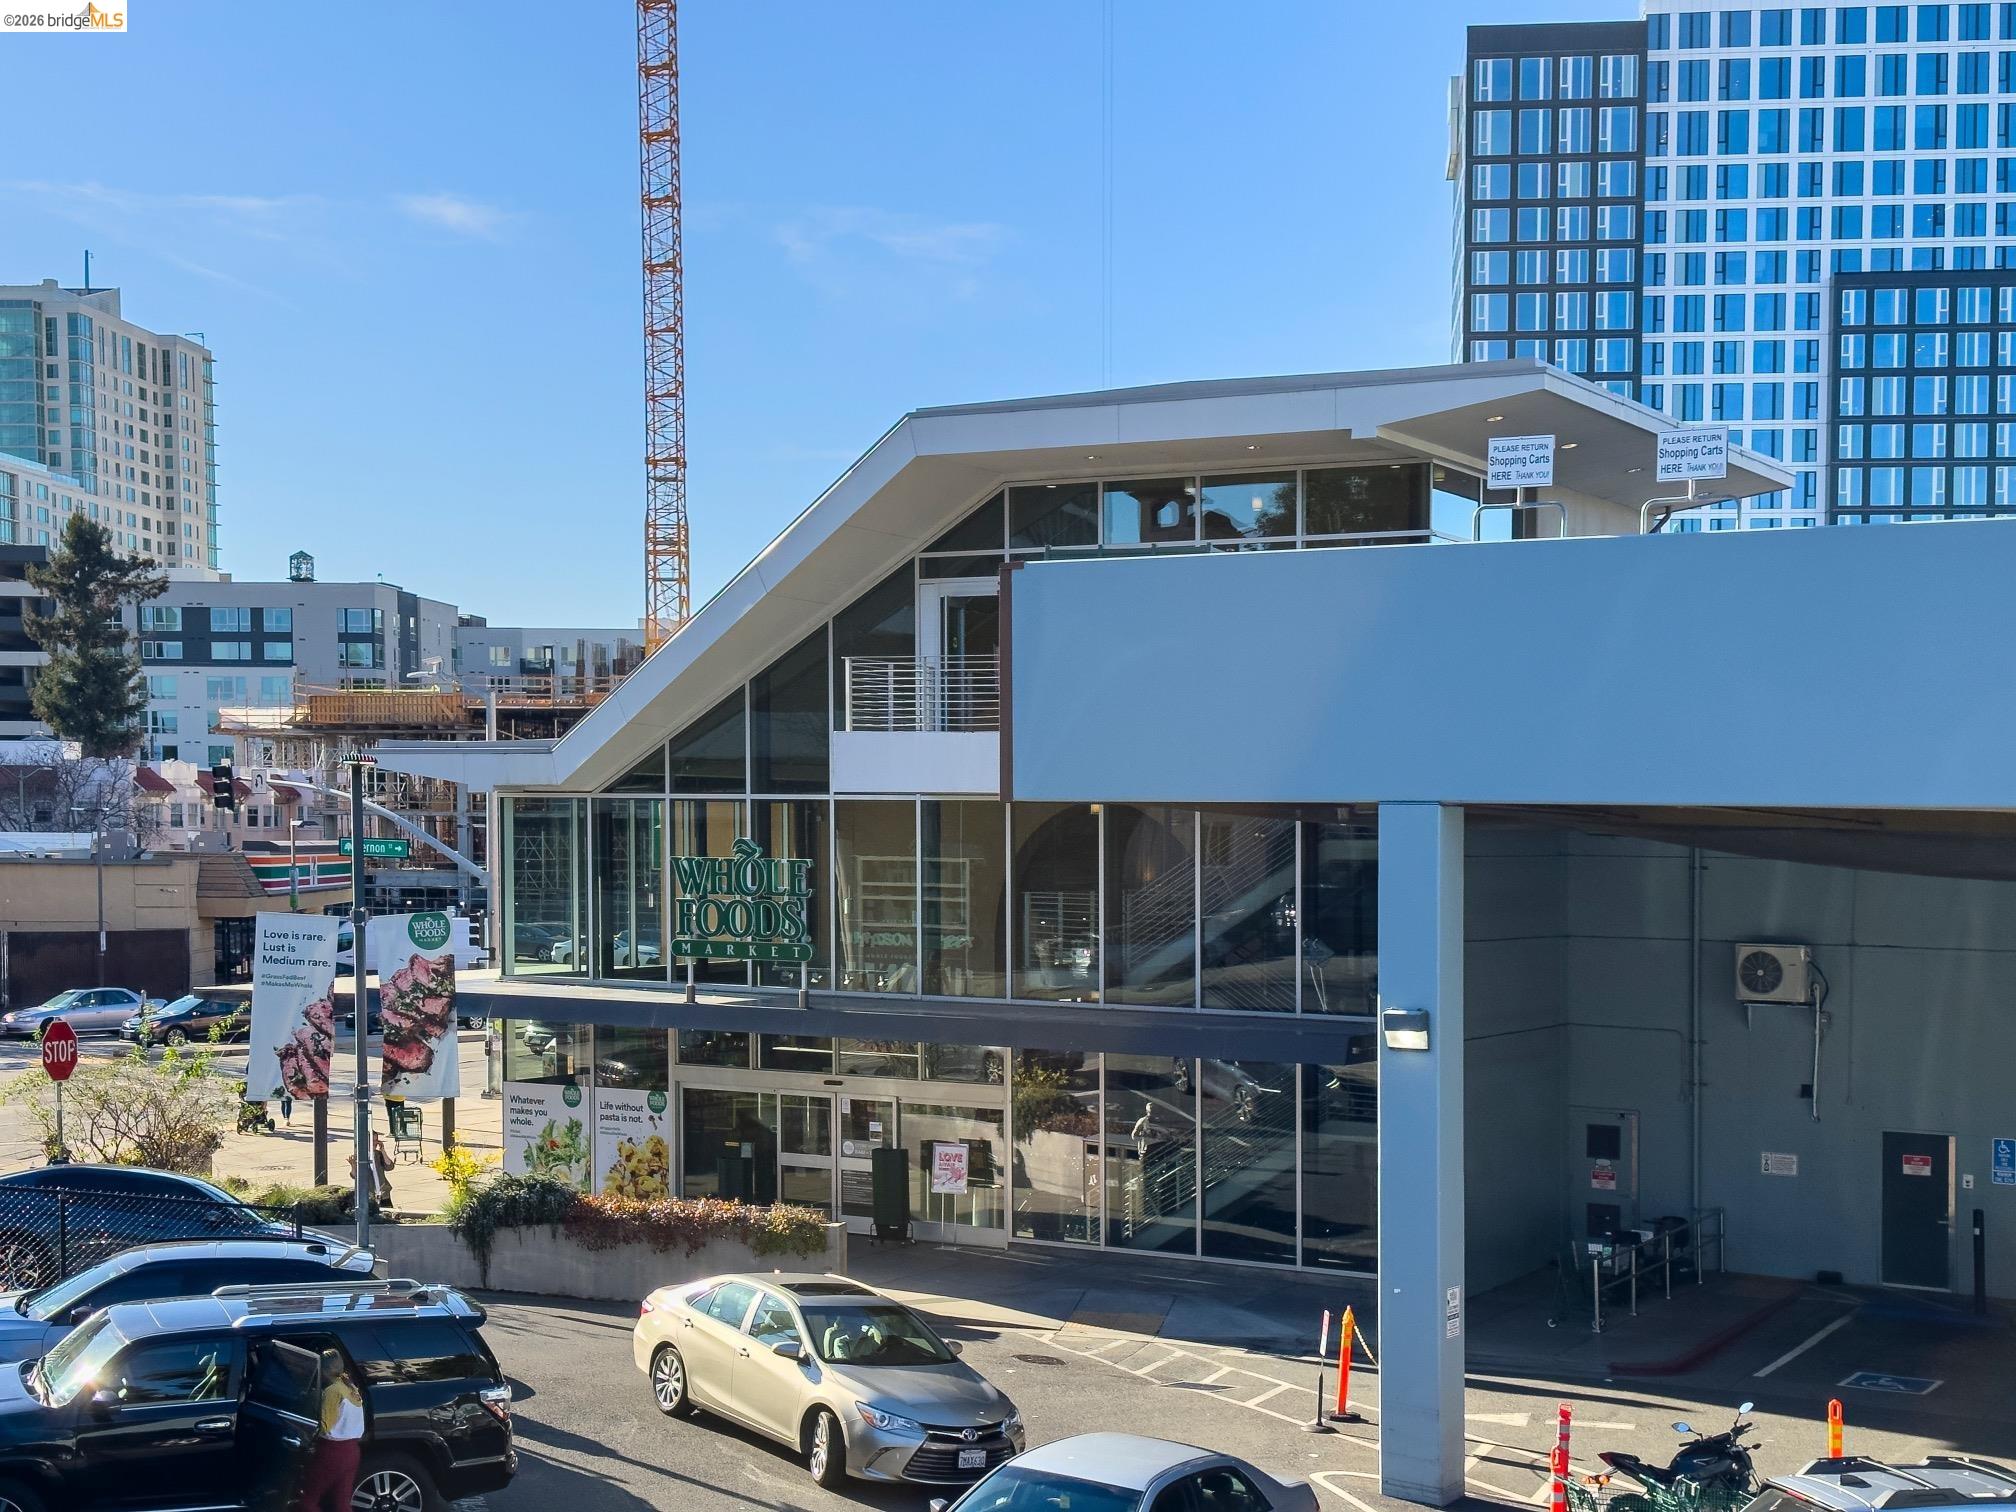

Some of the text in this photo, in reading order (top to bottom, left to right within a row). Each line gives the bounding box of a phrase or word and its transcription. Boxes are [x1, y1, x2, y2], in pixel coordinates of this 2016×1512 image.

[1663, 434, 1722, 445] PLEASE RETURN
[1493, 443, 1549, 453] PLEASE RETURN
[1659, 445, 1724, 460] Shopping Carts
[1490, 453, 1550, 468] Shopping Carts
[1660, 463, 1682, 474] HERE
[1491, 471, 1511, 480] HERE
[363, 844, 386, 853] ernon
[670, 856, 814, 898] WHOLE
[412, 920, 447, 930] WHOLE
[675, 898, 808, 941] FOODS
[263, 929, 327, 942] Love is rare.
[415, 928, 446, 938] FOODS
[263, 942, 296, 952] Lust is
[681, 943, 801, 958] MARKET
[262, 955, 332, 967] Medium rare.
[45, 1039, 76, 1064] STOP
[509, 1094, 546, 1106] Whatever
[509, 1106, 548, 1117] makes you
[600, 1101, 644, 1113] Life without
[509, 1117, 534, 1126] whole.
[600, 1113, 643, 1124] pasta is not.
[938, 1151, 963, 1163] LOVE
